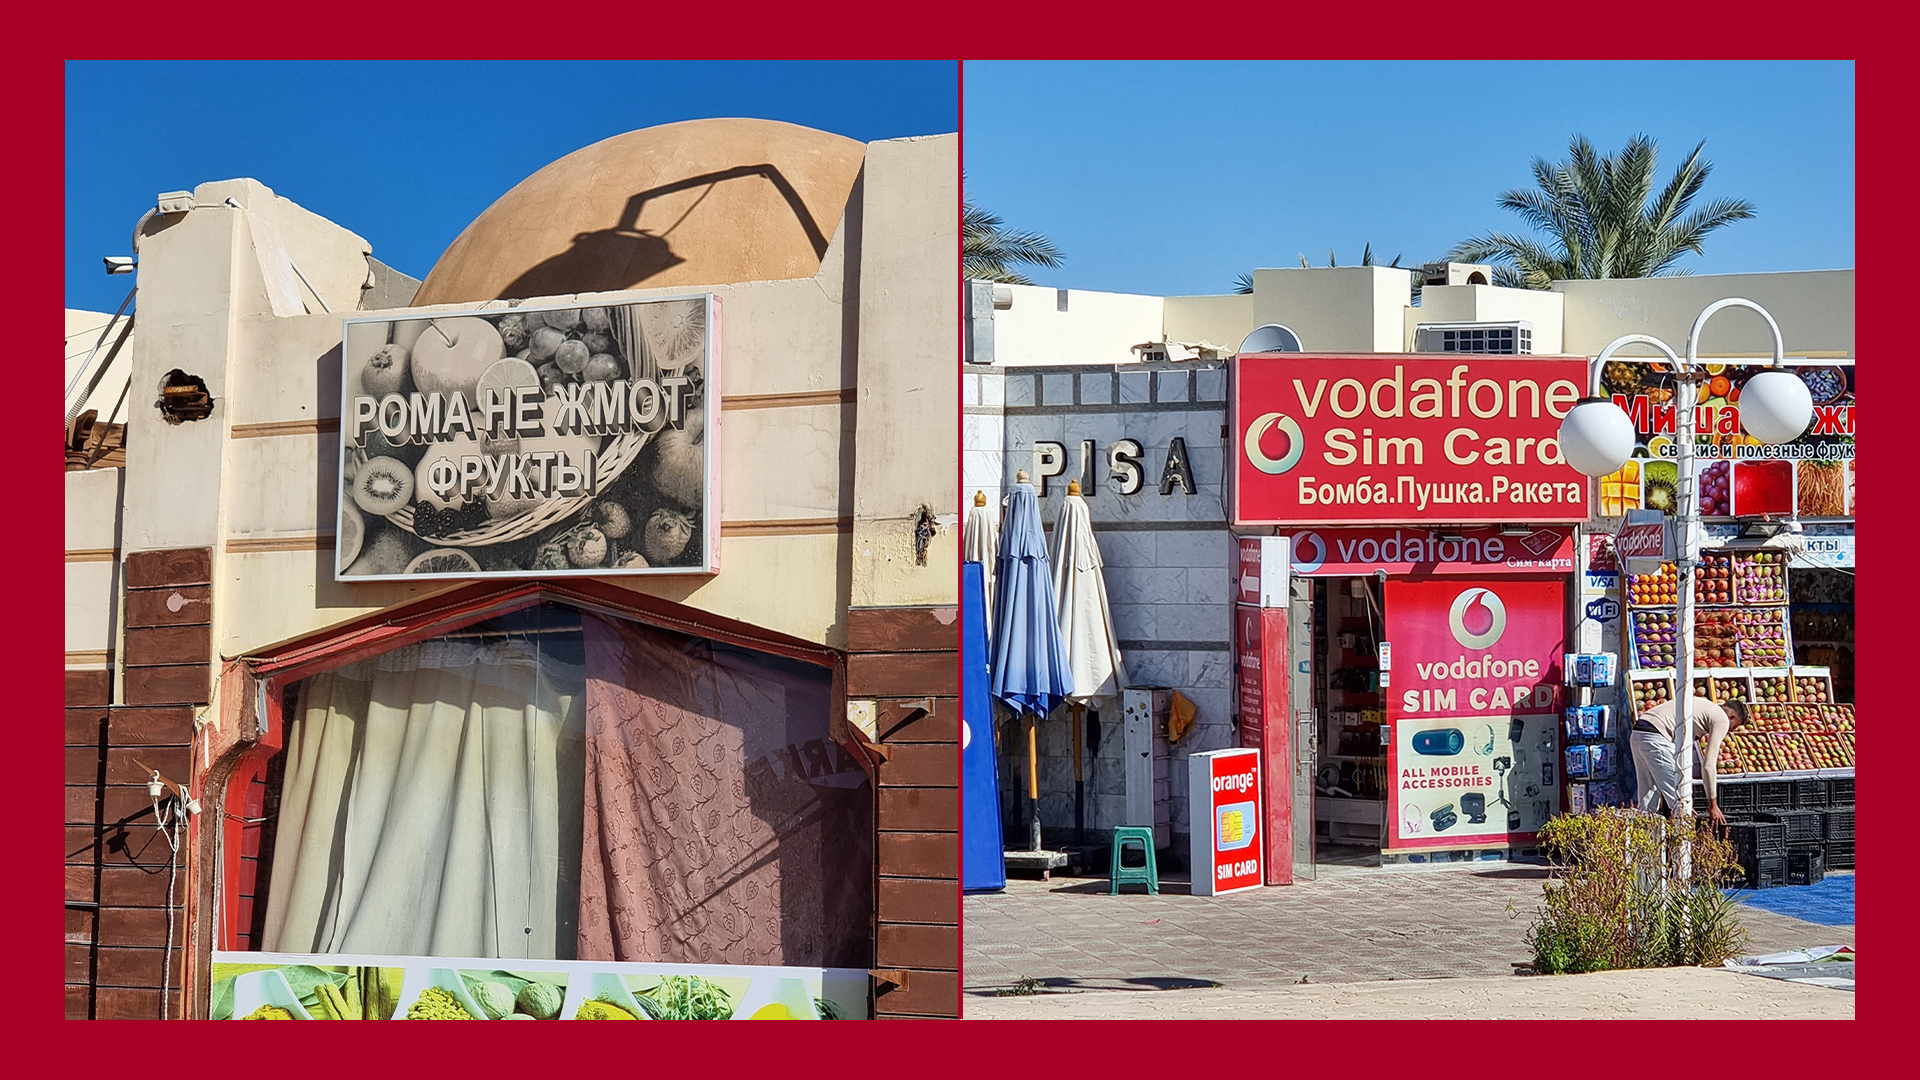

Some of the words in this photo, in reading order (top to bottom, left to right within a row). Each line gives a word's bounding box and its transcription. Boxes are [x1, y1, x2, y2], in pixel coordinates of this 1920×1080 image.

[1292, 365, 1580, 419] vodafone
[353, 390, 476, 447] РОМА
[484, 385, 546, 441] НЕ
[552, 376, 695, 436] ЖМОТ
[1612, 394, 1740, 435] Миша
[1323, 428, 1424, 467] Sim
[1444, 427, 1566, 467] Card
[1659, 444, 1719, 458] свие
[1722, 444, 1732, 458] и
[1736, 444, 1814, 458] полезные
[426, 448, 599, 502] ФРУКТЫ
[1032, 437, 1198, 497] PISA
[1299, 476, 1581, 511] Бомба.Пушка.Ракета
[1335, 531, 1505, 564] vodafone
[1617, 530, 1661, 551] vodafone
[1506, 556, 1573, 570] Сим-карта
[1590, 577, 1615, 588] VISA
[1416, 654, 1540, 681] vodafone
[1402, 688, 1457, 713] SIM
[1469, 685, 1553, 711] CARD
[1401, 776, 1493, 790] ACCESSORIES
[1402, 768, 1426, 779] ALL
[1431, 765, 1480, 777] MOBILE
[1217, 862, 1233, 880] SIM
[1234, 858, 1258, 878] CARD
